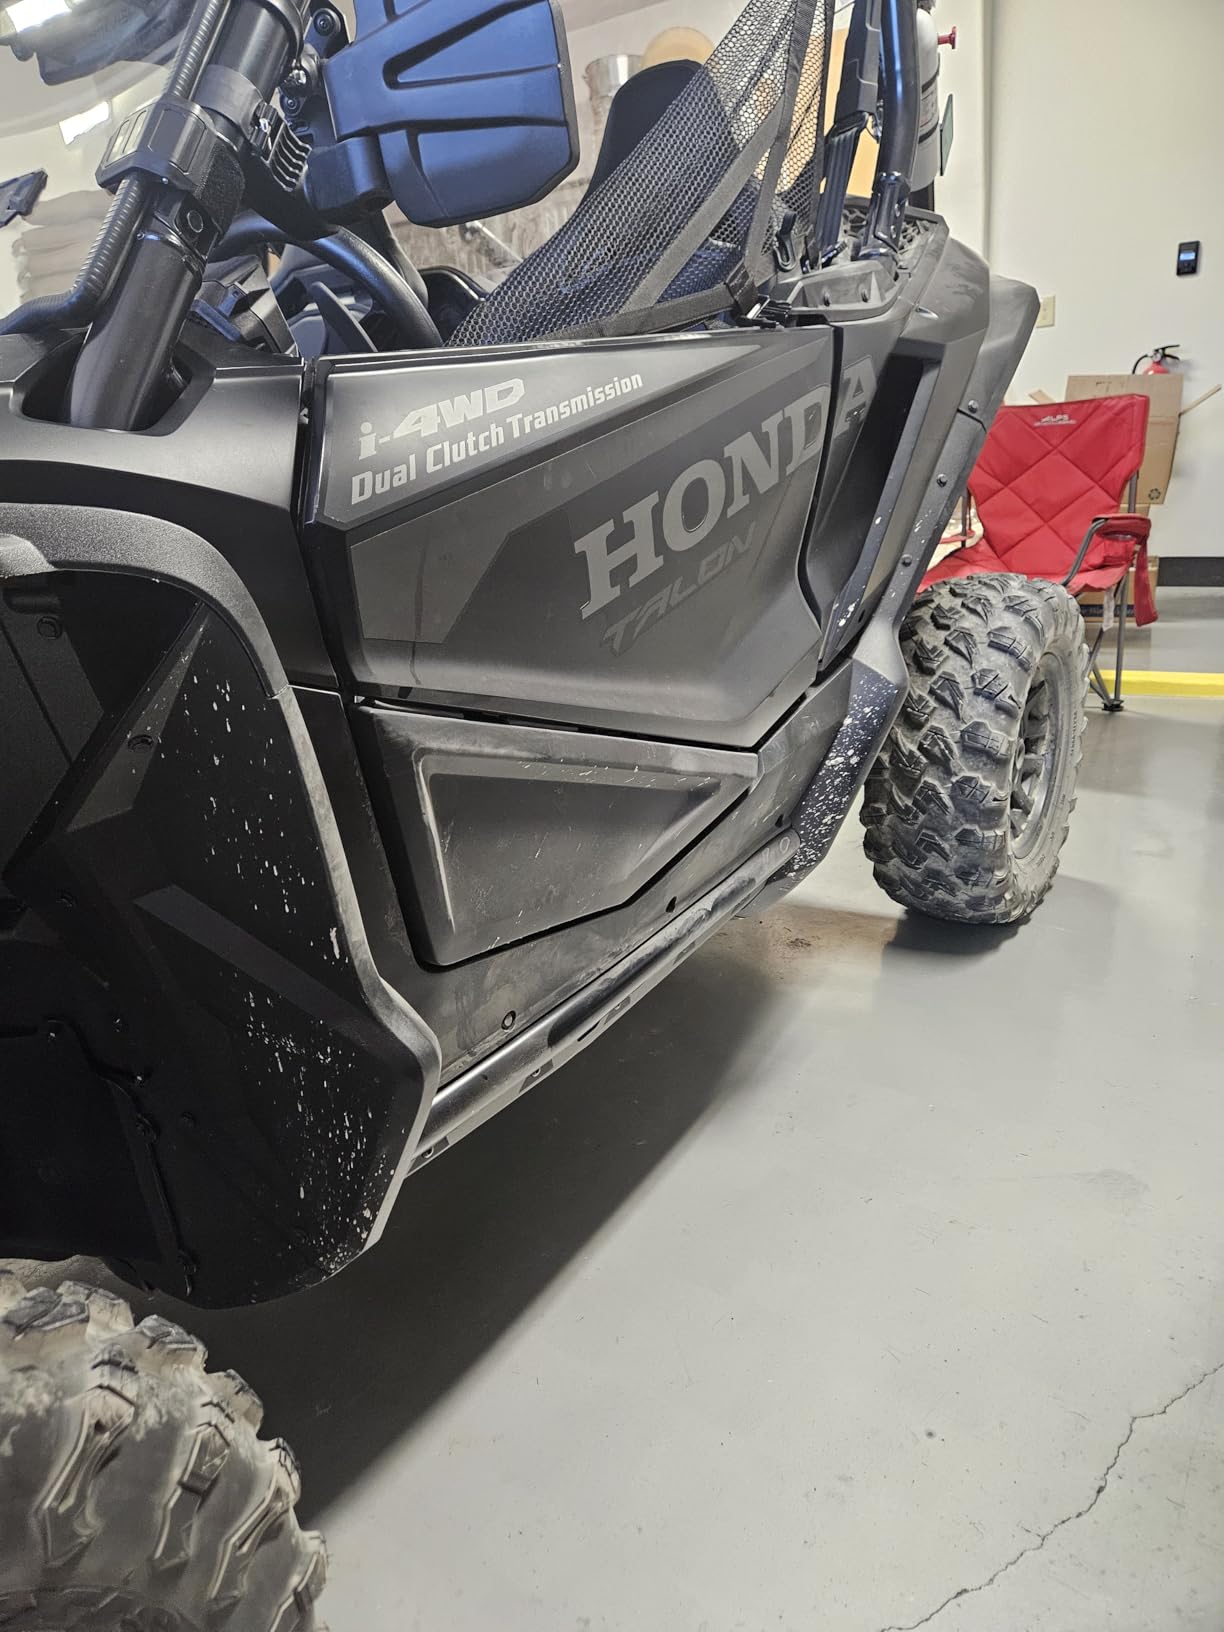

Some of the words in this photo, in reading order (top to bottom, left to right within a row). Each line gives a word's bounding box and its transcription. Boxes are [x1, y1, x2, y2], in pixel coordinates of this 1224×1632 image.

[351, 453, 417, 505] Dual
[425, 423, 505, 474] Clutch
[506, 373, 644, 438] Transmission
[358, 377, 526, 461] i-4WD
[573, 354, 877, 620] HONDA
[601, 521, 757, 655] TALON
